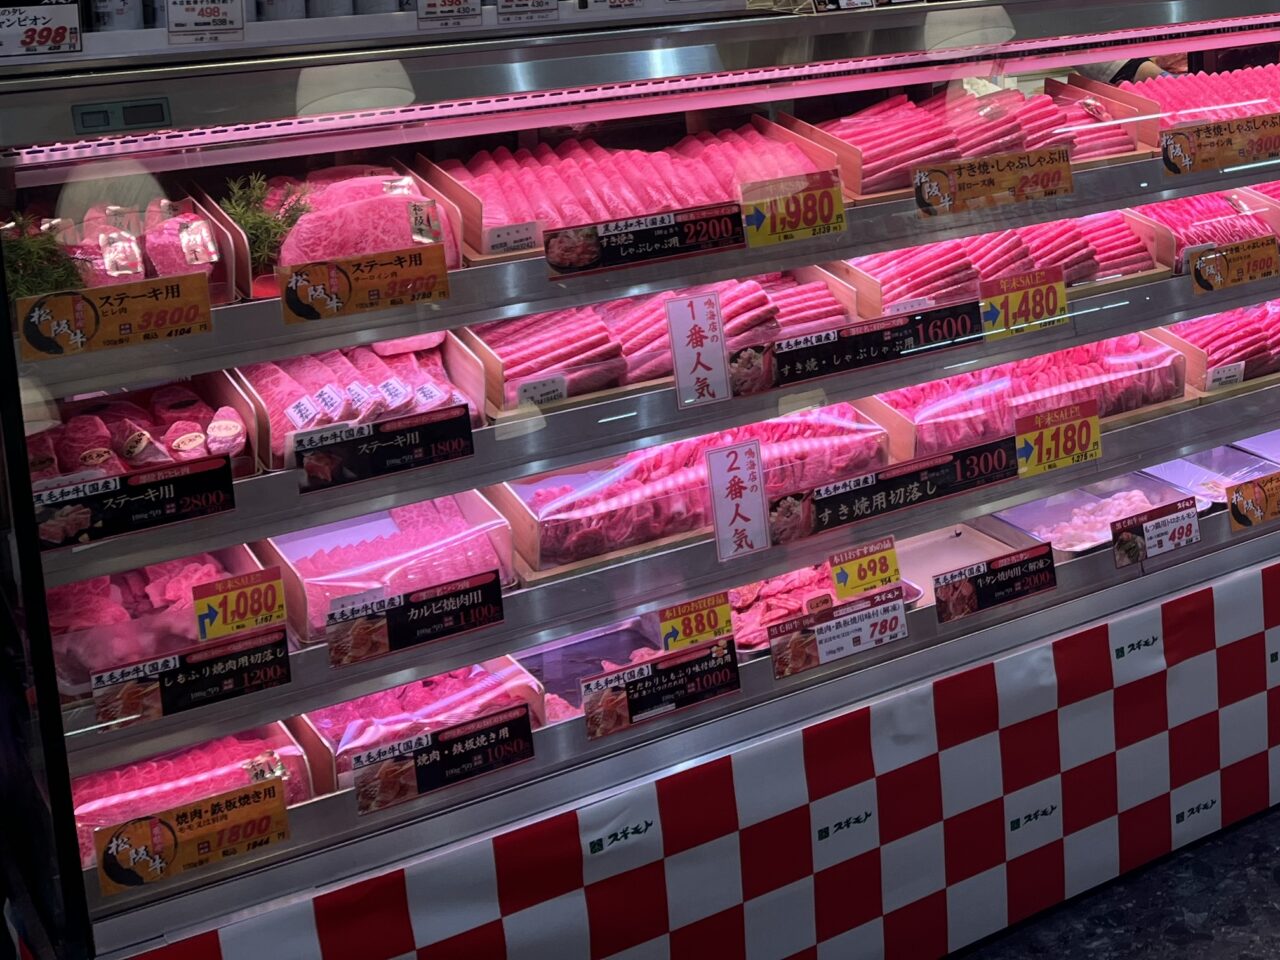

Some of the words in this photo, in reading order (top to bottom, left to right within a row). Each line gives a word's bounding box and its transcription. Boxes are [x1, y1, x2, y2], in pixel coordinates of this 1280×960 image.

[198, 7, 220, 18] 498
[21, 26, 67, 46] 398
[765, 191, 834, 233] 1,980
[683, 216, 733, 242] 2200
[352, 253, 423, 277] ステーキ用
[1246, 256, 1273, 271] 1500
[98, 284, 180, 308] ステーキ用
[1000, 285, 1058, 328] 1,480
[31, 307, 87, 349] 松阪牛
[138, 305, 200, 330] 3800
[916, 313, 971, 345] 1600
[686, 301, 715, 401] 1番人気
[1033, 419, 1090, 465] 1,180
[952, 449, 1007, 483] 1300
[103, 486, 174, 510] ステーキ用
[180, 489, 225, 512] 2800
[726, 451, 754, 552] 2番人気
[818, 481, 937, 525] すき焼用切落し
[1168, 522, 1193, 543] 498
[857, 557, 890, 579] 698
[218, 584, 276, 624] 1,080
[407, 591, 482, 621] カルビ焼肉用
[681, 609, 719, 638] 880
[869, 616, 899, 640] 780
[1127, 634, 1159, 654] スギモト
[176, 786, 276, 827] 焼肉・鉄板焼き用
[217, 817, 271, 846] 1800
[607, 820, 654, 846] スギモト
[834, 811, 873, 833] スギモト
